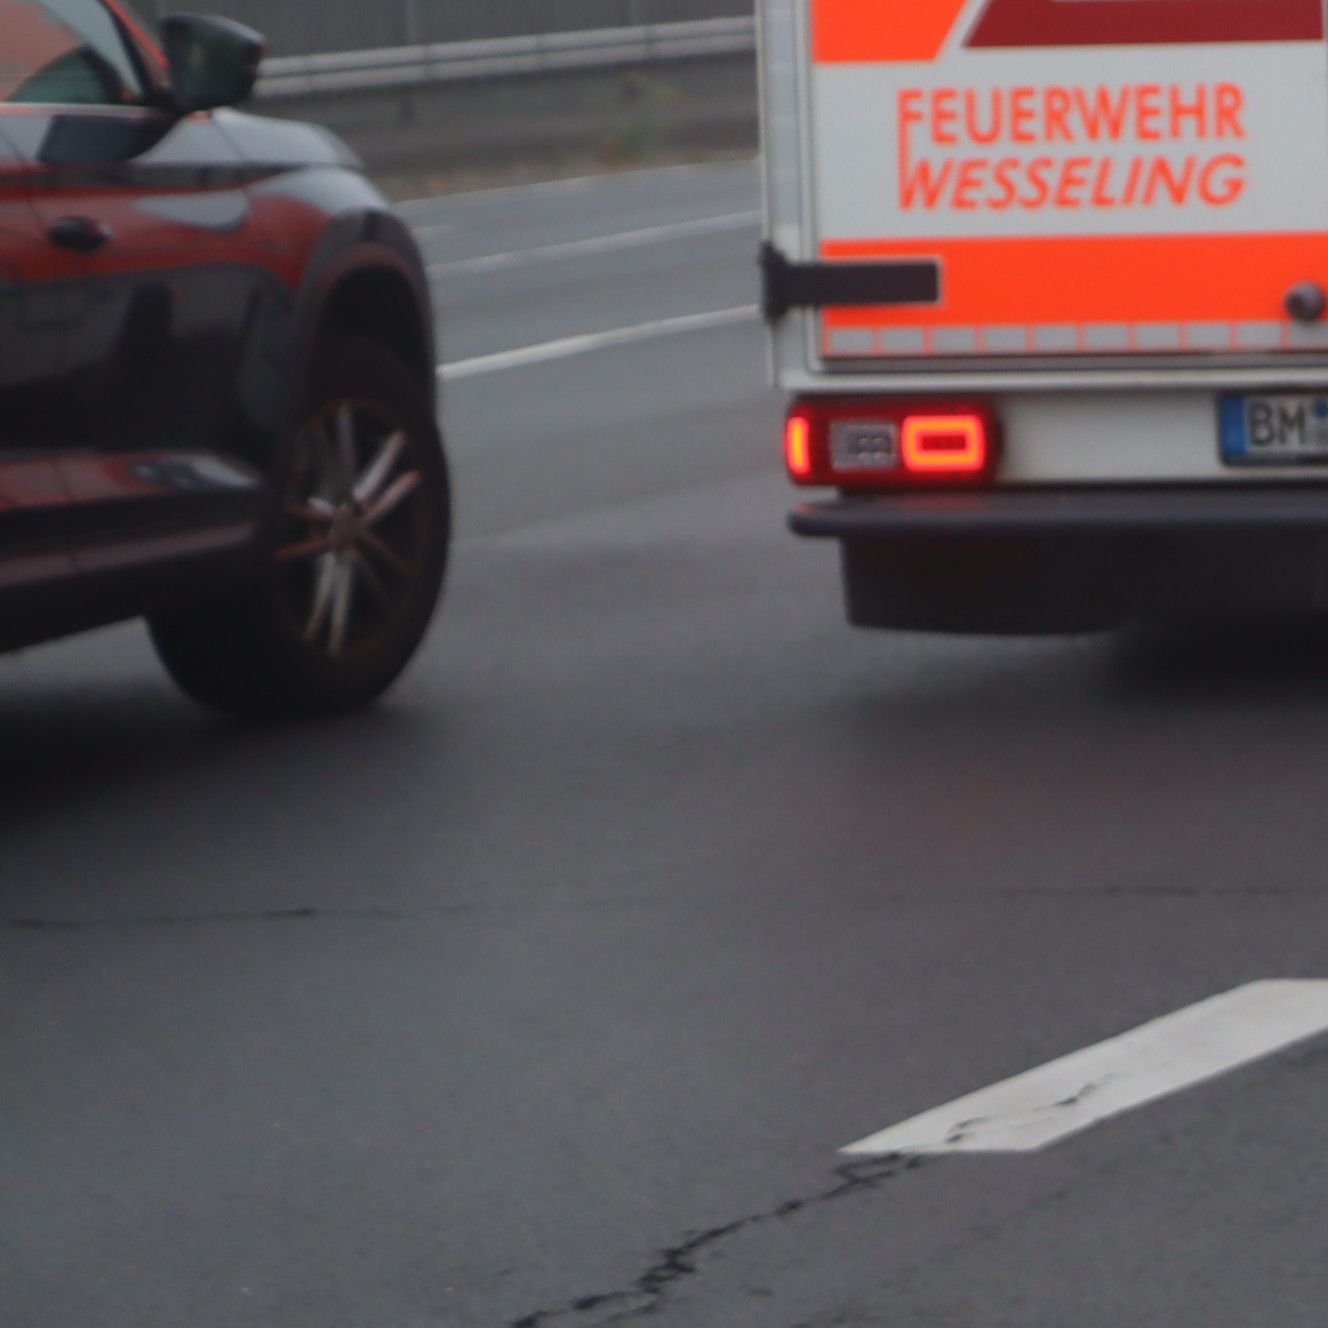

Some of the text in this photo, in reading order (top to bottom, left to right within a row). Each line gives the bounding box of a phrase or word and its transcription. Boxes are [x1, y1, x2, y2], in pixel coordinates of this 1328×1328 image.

[897, 82, 1246, 146] FEUERWEHR
[897, 154, 1246, 210] WESSELING
[1249, 402, 1306, 447] BM
